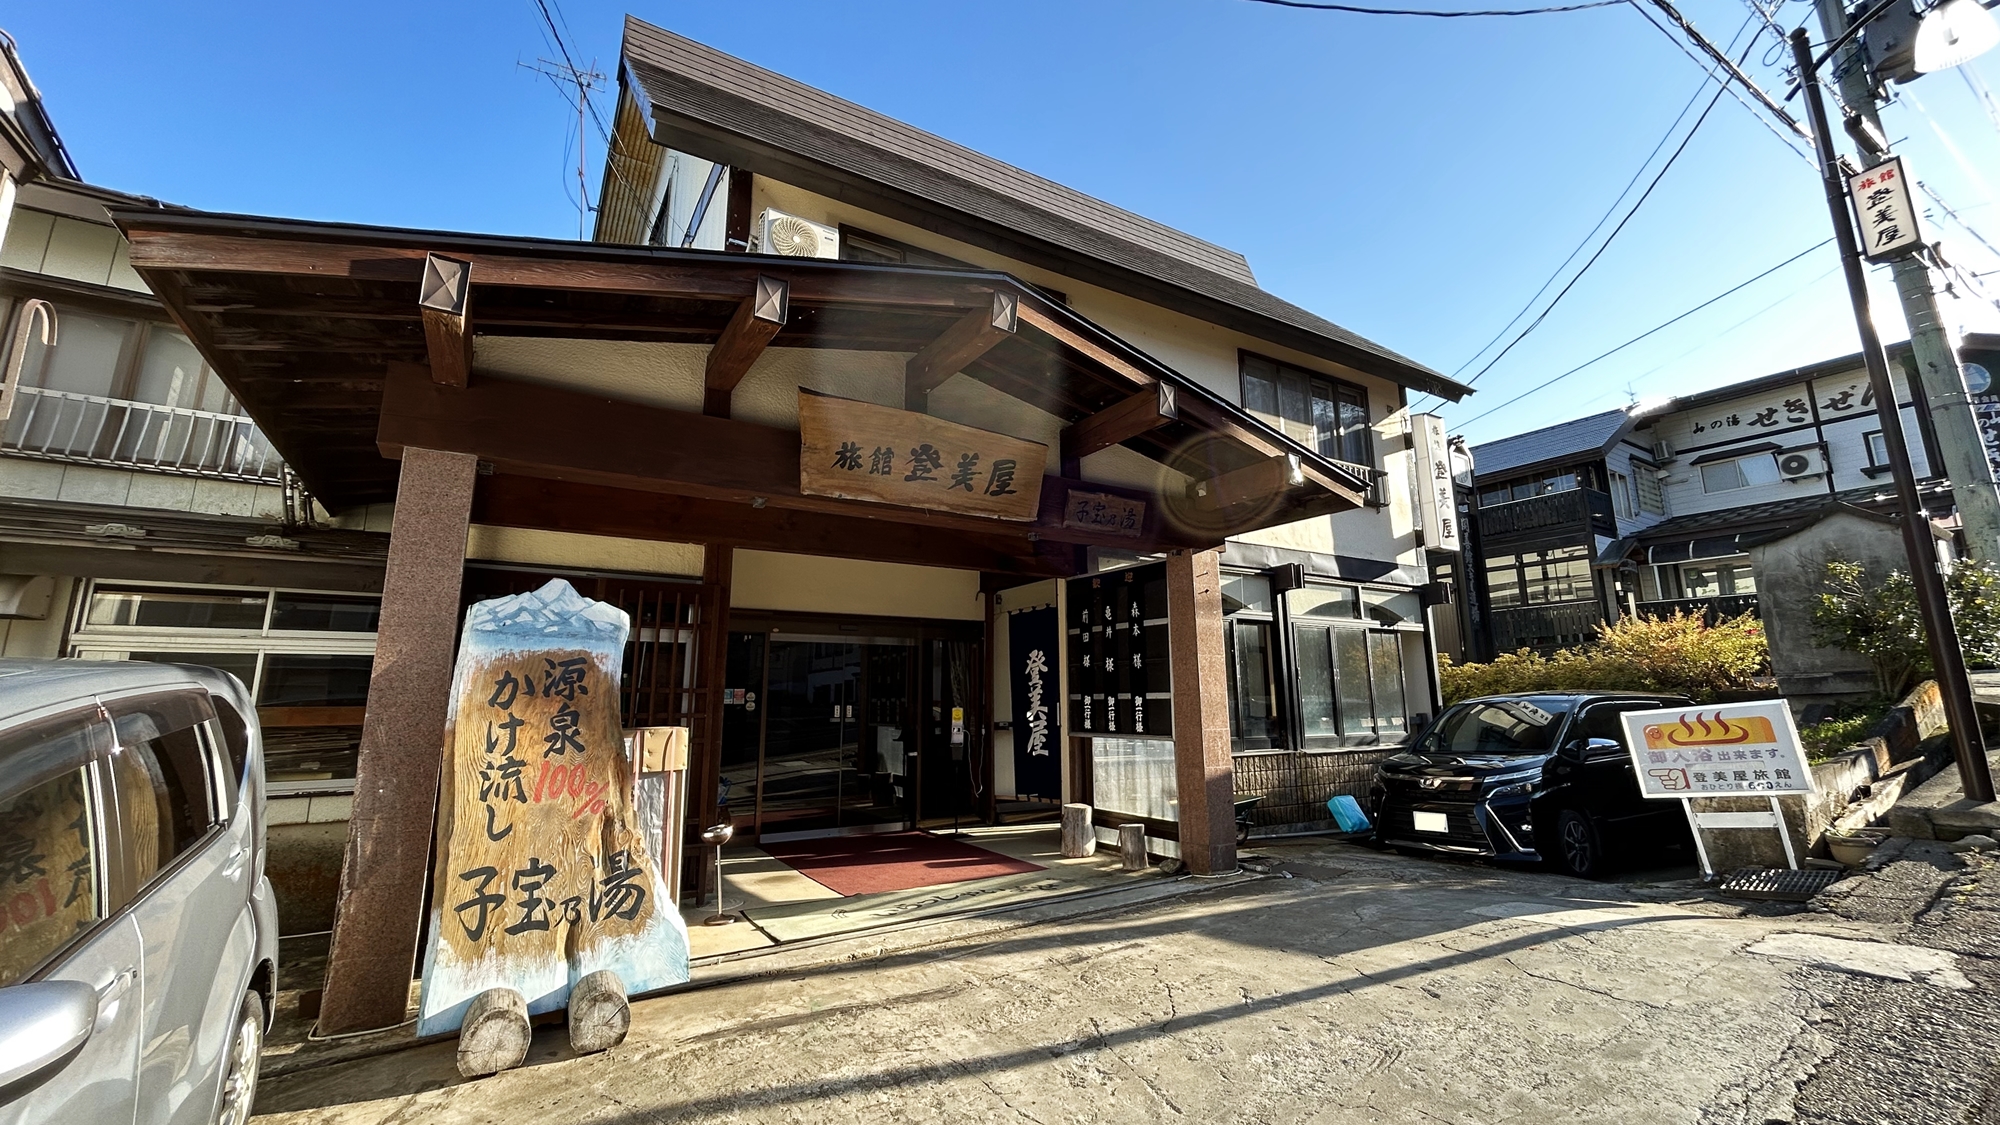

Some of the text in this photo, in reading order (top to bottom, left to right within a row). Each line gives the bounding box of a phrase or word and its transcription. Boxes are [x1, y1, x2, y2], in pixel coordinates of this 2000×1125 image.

[1857, 169, 1895, 192] 旅館
[1866, 187, 1906, 248] 登美屋
[831, 441, 1017, 497] 旅館登美屋
[1075, 500, 1138, 529] 子宝乃湯
[542, 657, 588, 758] 源泉
[1025, 649, 1049, 757] 登美屋
[479, 670, 535, 842] かけ流し
[1693, 768, 1792, 783] 登美屋旅館
[533, 760, 609, 819] 100%
[454, 850, 646, 942] 子宝乃湯
